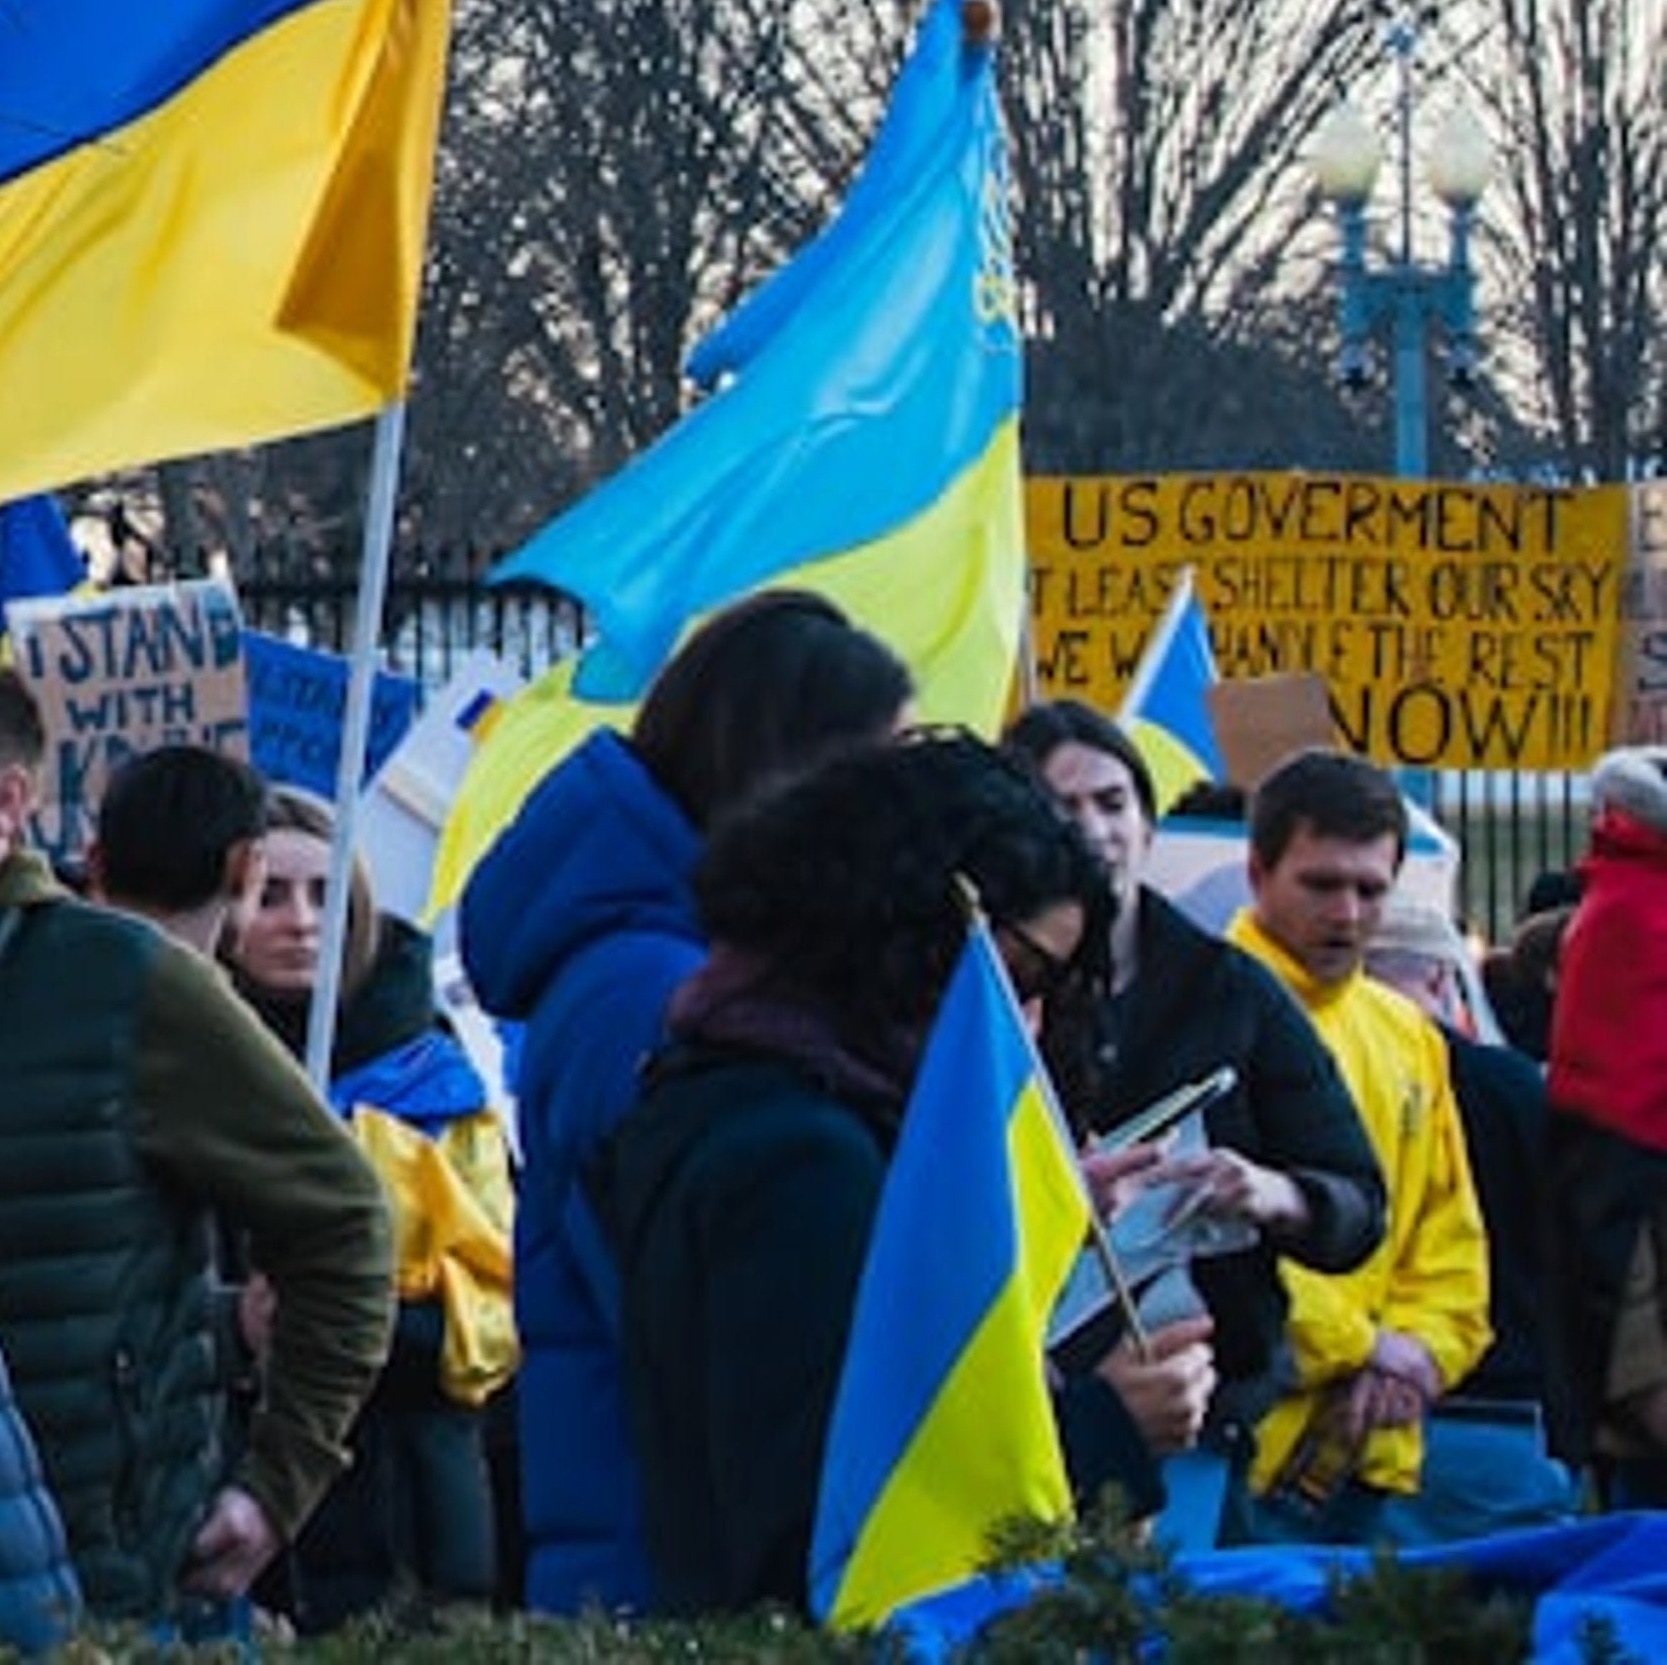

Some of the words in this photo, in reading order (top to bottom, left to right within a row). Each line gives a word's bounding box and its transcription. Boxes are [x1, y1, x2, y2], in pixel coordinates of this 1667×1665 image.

[1063, 480, 1159, 548] US
[1178, 477, 1577, 553] GOVERMENT
[1212, 555, 1411, 619] SHELTER
[1430, 559, 1519, 623] OUR
[1529, 559, 1613, 623] SKY
[26, 634, 44, 678] I
[58, 591, 241, 682] STAND
[1367, 621, 1445, 684] THE
[1470, 630, 1595, 690] REST
[65, 681, 195, 731] WITH
